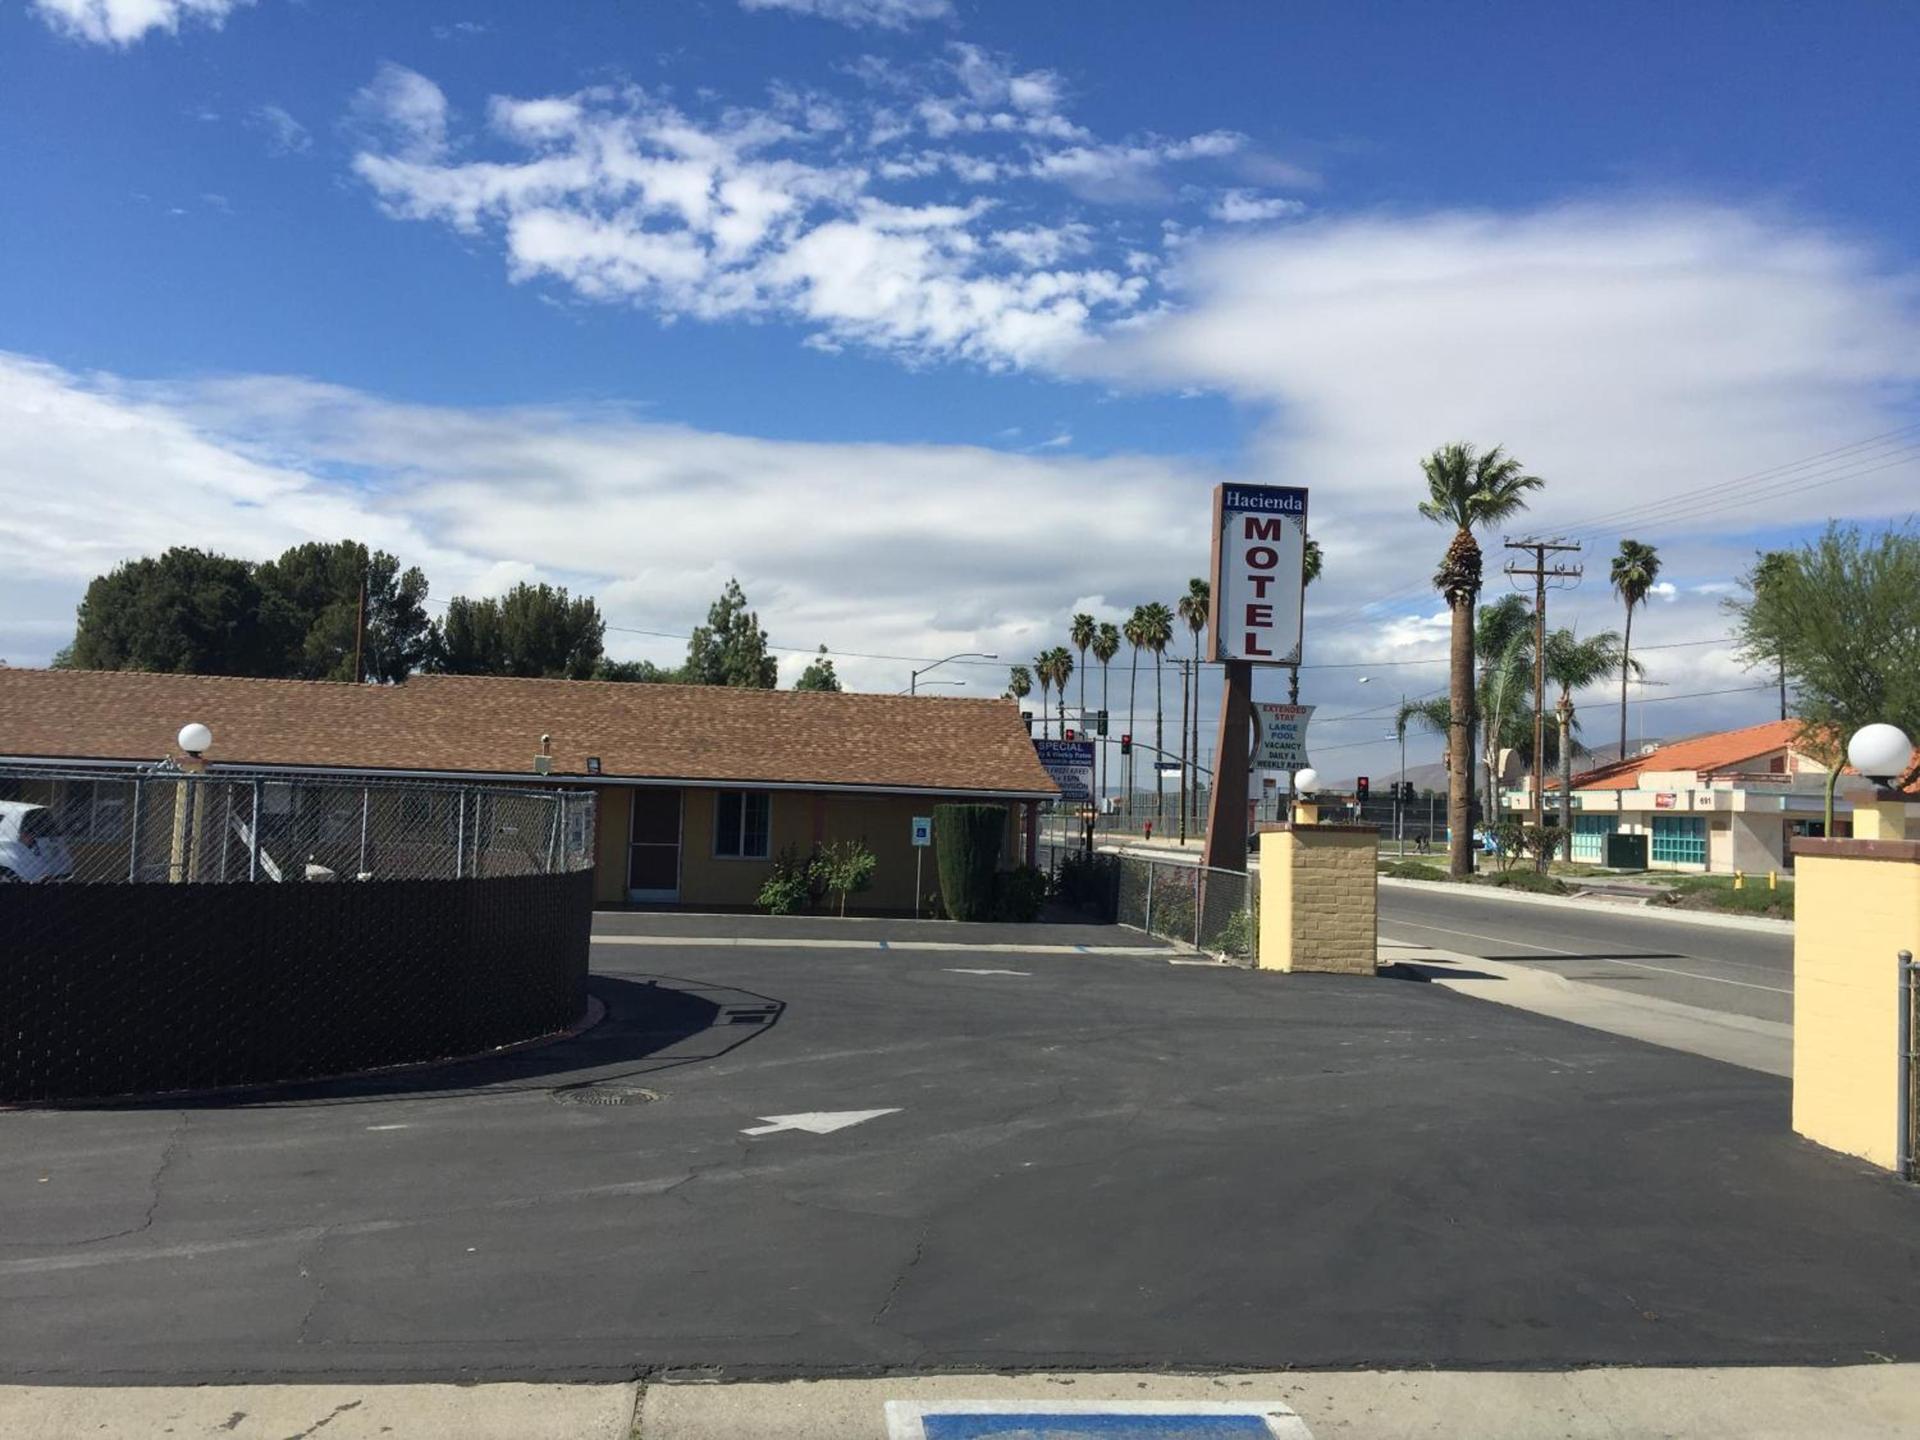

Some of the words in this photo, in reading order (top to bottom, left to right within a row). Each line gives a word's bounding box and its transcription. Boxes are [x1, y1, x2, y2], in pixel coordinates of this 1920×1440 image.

[1227, 491, 1304, 511] Hacienda
[1244, 517, 1282, 656] MOTEL
[1263, 705, 1307, 714] EXTENDED
[1274, 713, 1295, 721] STAY
[1269, 723, 1298, 732] LARGE
[1271, 732, 1296, 740] POOL
[1038, 742, 1084, 752] SPECIAL
[1264, 741, 1302, 751] VACANCY
[1269, 751, 1289, 760] DAILY
[1257, 760, 1286, 768] WEEKLY
[1699, 797, 1711, 805] 691
